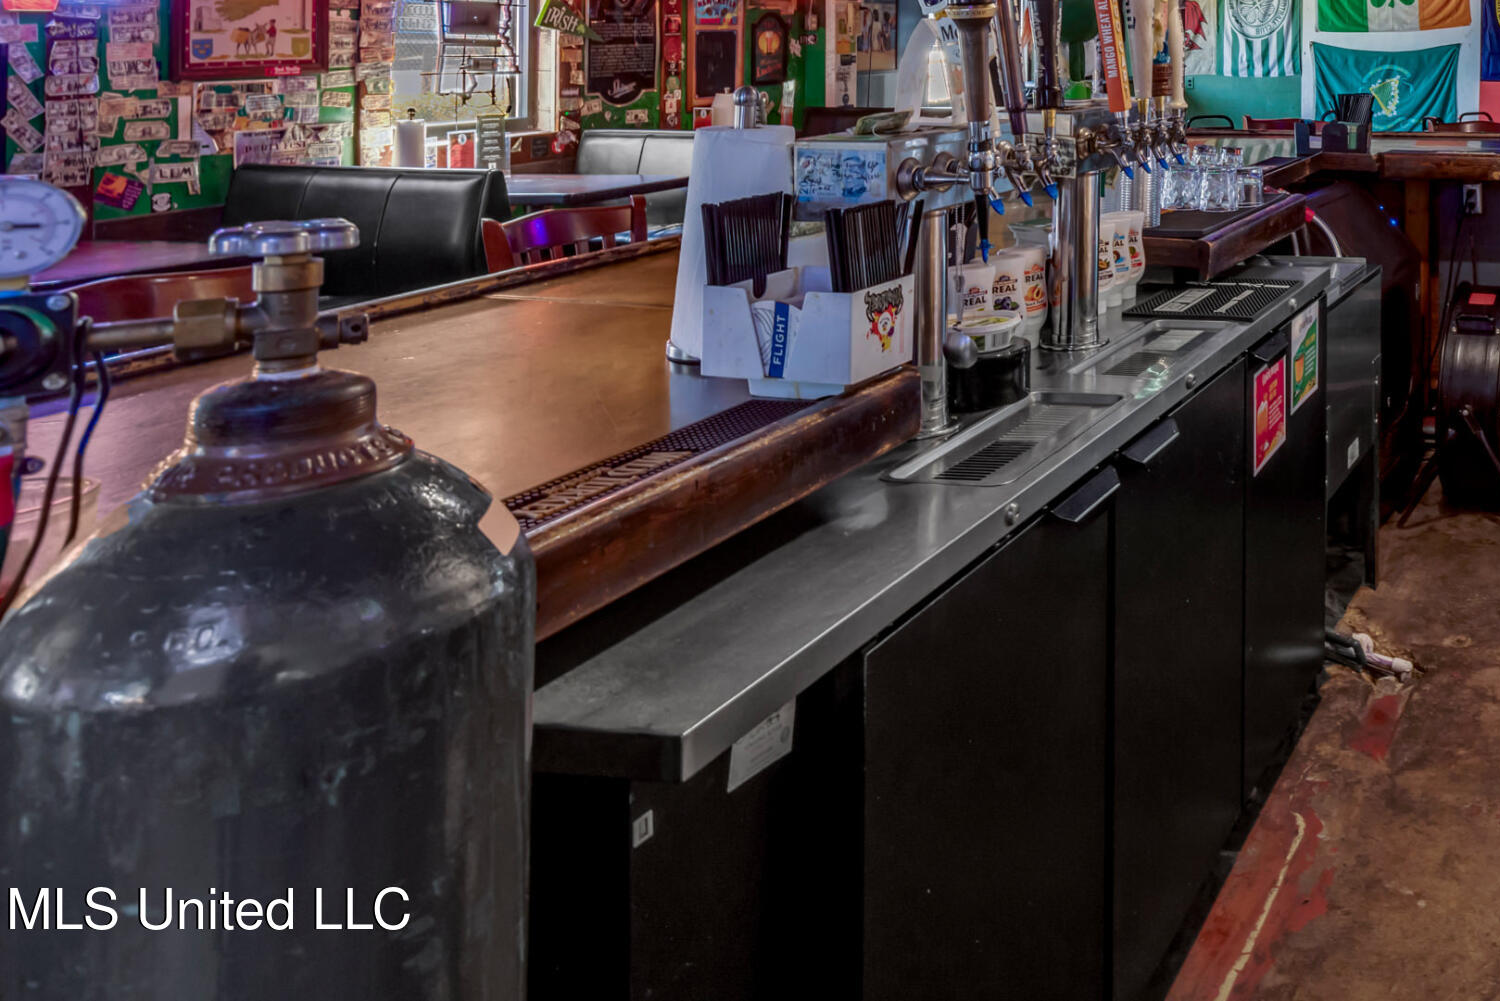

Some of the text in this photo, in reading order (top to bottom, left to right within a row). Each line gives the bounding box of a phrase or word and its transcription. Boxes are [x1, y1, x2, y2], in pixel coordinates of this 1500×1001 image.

[544, 6, 578, 32] IRISH
[1100, 9, 1114, 46] WHEAT
[1105, 45, 1119, 79] MANGO
[992, 284, 1017, 295] REAL
[1025, 273, 1045, 283] REAL
[964, 295, 987, 306] REAL
[773, 313, 788, 366] FLIGHT
